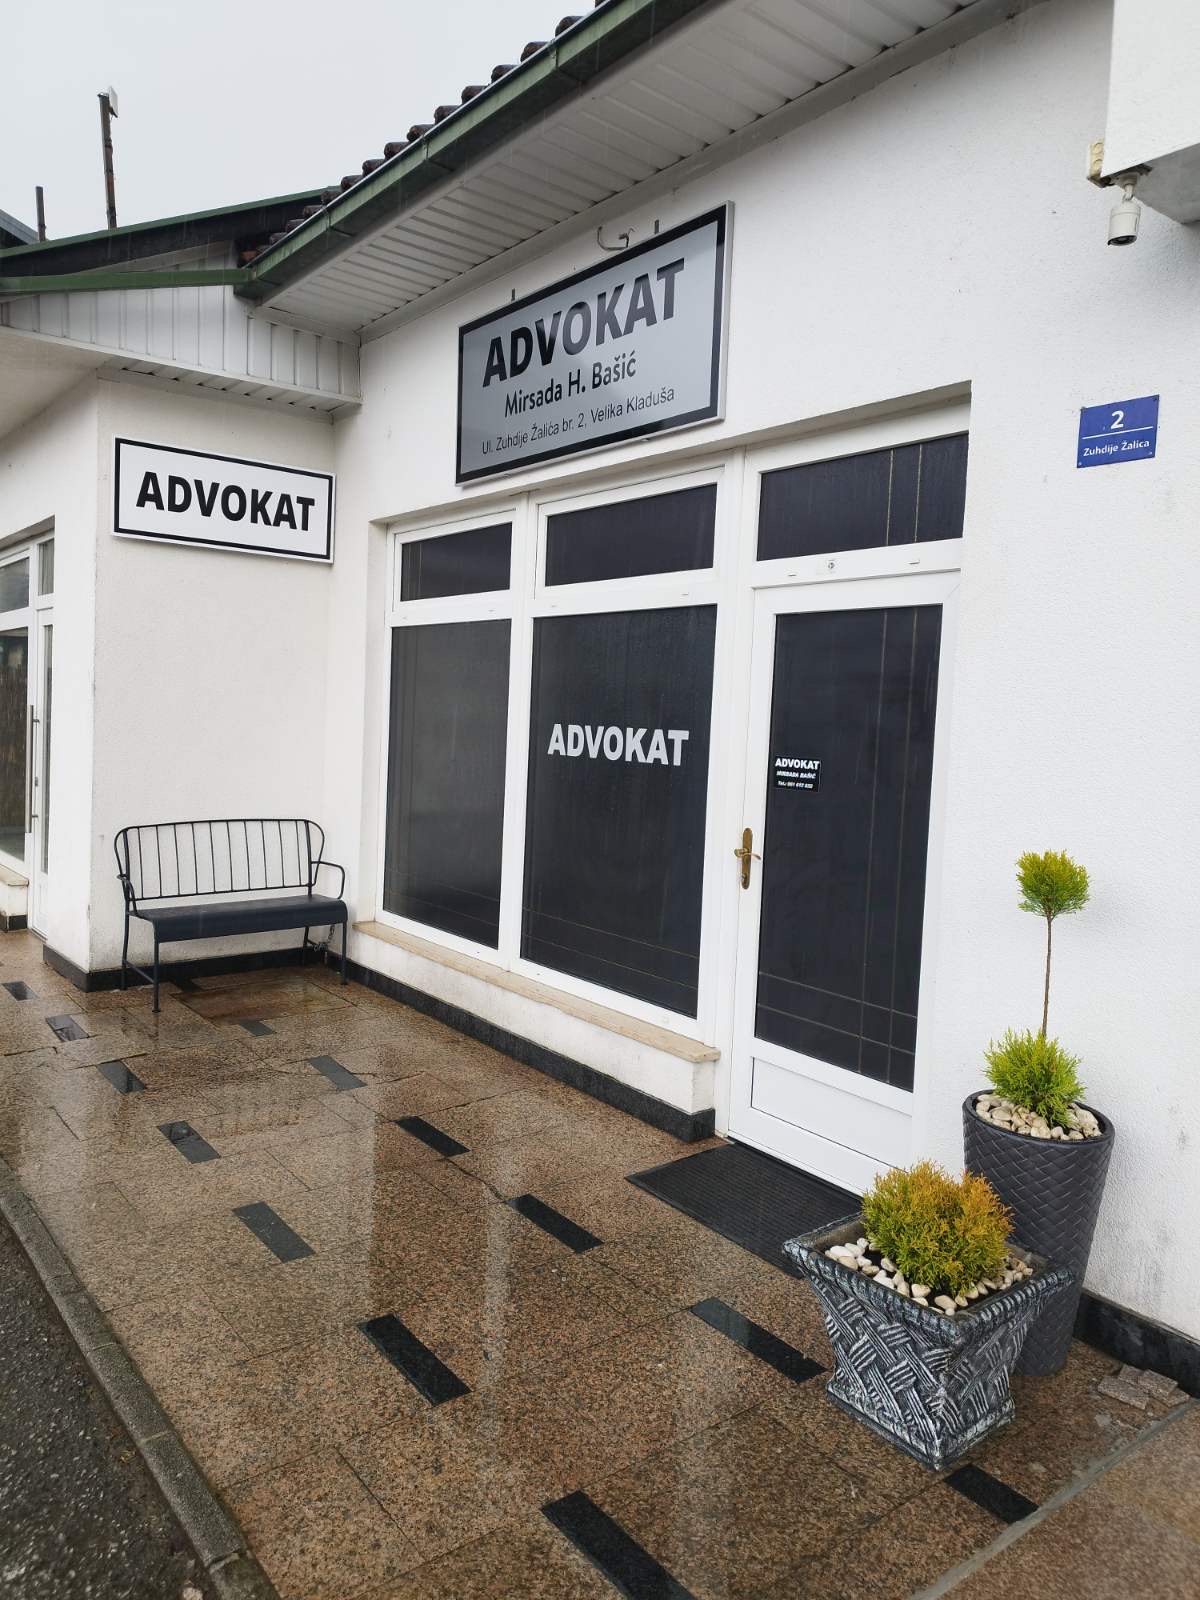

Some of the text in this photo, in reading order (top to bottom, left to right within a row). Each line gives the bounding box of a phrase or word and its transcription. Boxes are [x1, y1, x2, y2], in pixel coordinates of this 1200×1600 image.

[482, 257, 685, 388] ADVOKAT
[504, 350, 637, 418] Mirsada H. Bašić
[482, 440, 493, 455] Ul.
[495, 431, 529, 452] Zuhdije
[530, 423, 559, 442] Žalića
[561, 417, 575, 433] br.
[590, 403, 624, 423] Velika
[627, 386, 675, 412] Kladuša
[1110, 410, 1125, 430] 2
[1083, 445, 1119, 456] Zuhdije
[136, 471, 316, 532] ADVOKAT
[547, 723, 690, 766] ADVOKAT
[775, 758, 820, 770] ADVOKAT
